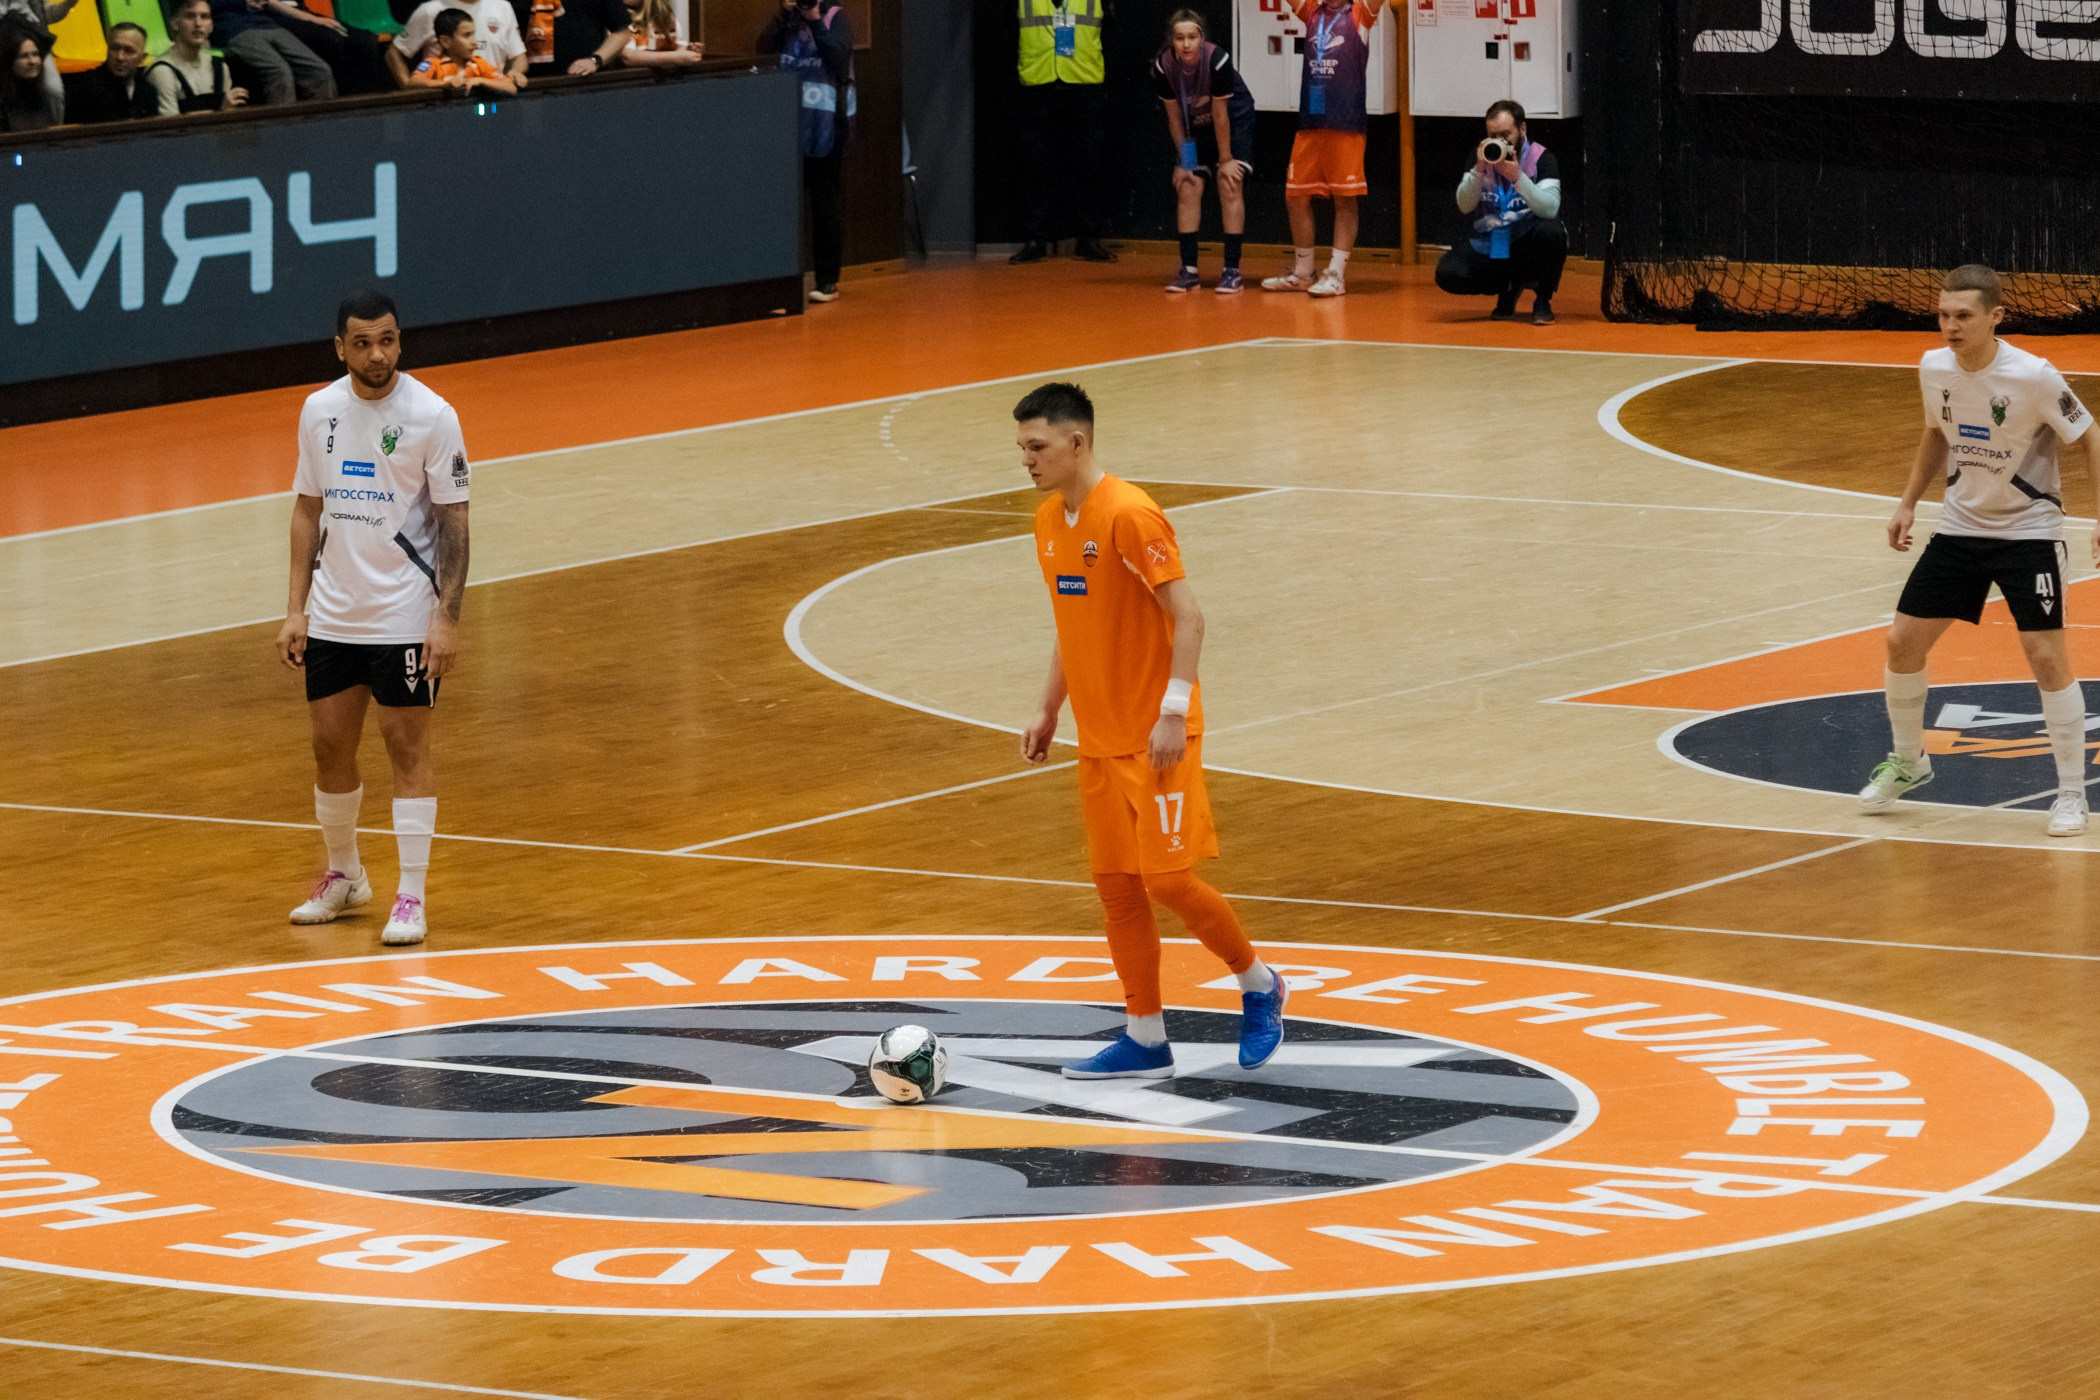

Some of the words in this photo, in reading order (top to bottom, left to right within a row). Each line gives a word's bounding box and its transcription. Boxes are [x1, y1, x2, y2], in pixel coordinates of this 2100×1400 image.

[1309, 59, 1339, 67] СПЕР
[13, 162, 398, 326] МЯЧ
[327, 436, 334, 453] 9
[1950, 444, 2012, 459] НГОССТРАХ
[324, 488, 395, 502] ИНГОССТРАХ
[1059, 581, 1086, 590] БЕТСИТИ
[2036, 572, 2054, 597] 41
[405, 648, 417, 675] 9
[1154, 792, 1184, 834] 17
[538, 955, 1122, 991] HARD
[1452, 991, 1926, 1138] HUMBLE
[1308, 1152, 1890, 1258] TRAIN
[166, 1218, 511, 1274] BE
[552, 1235, 1293, 1286] HARD
